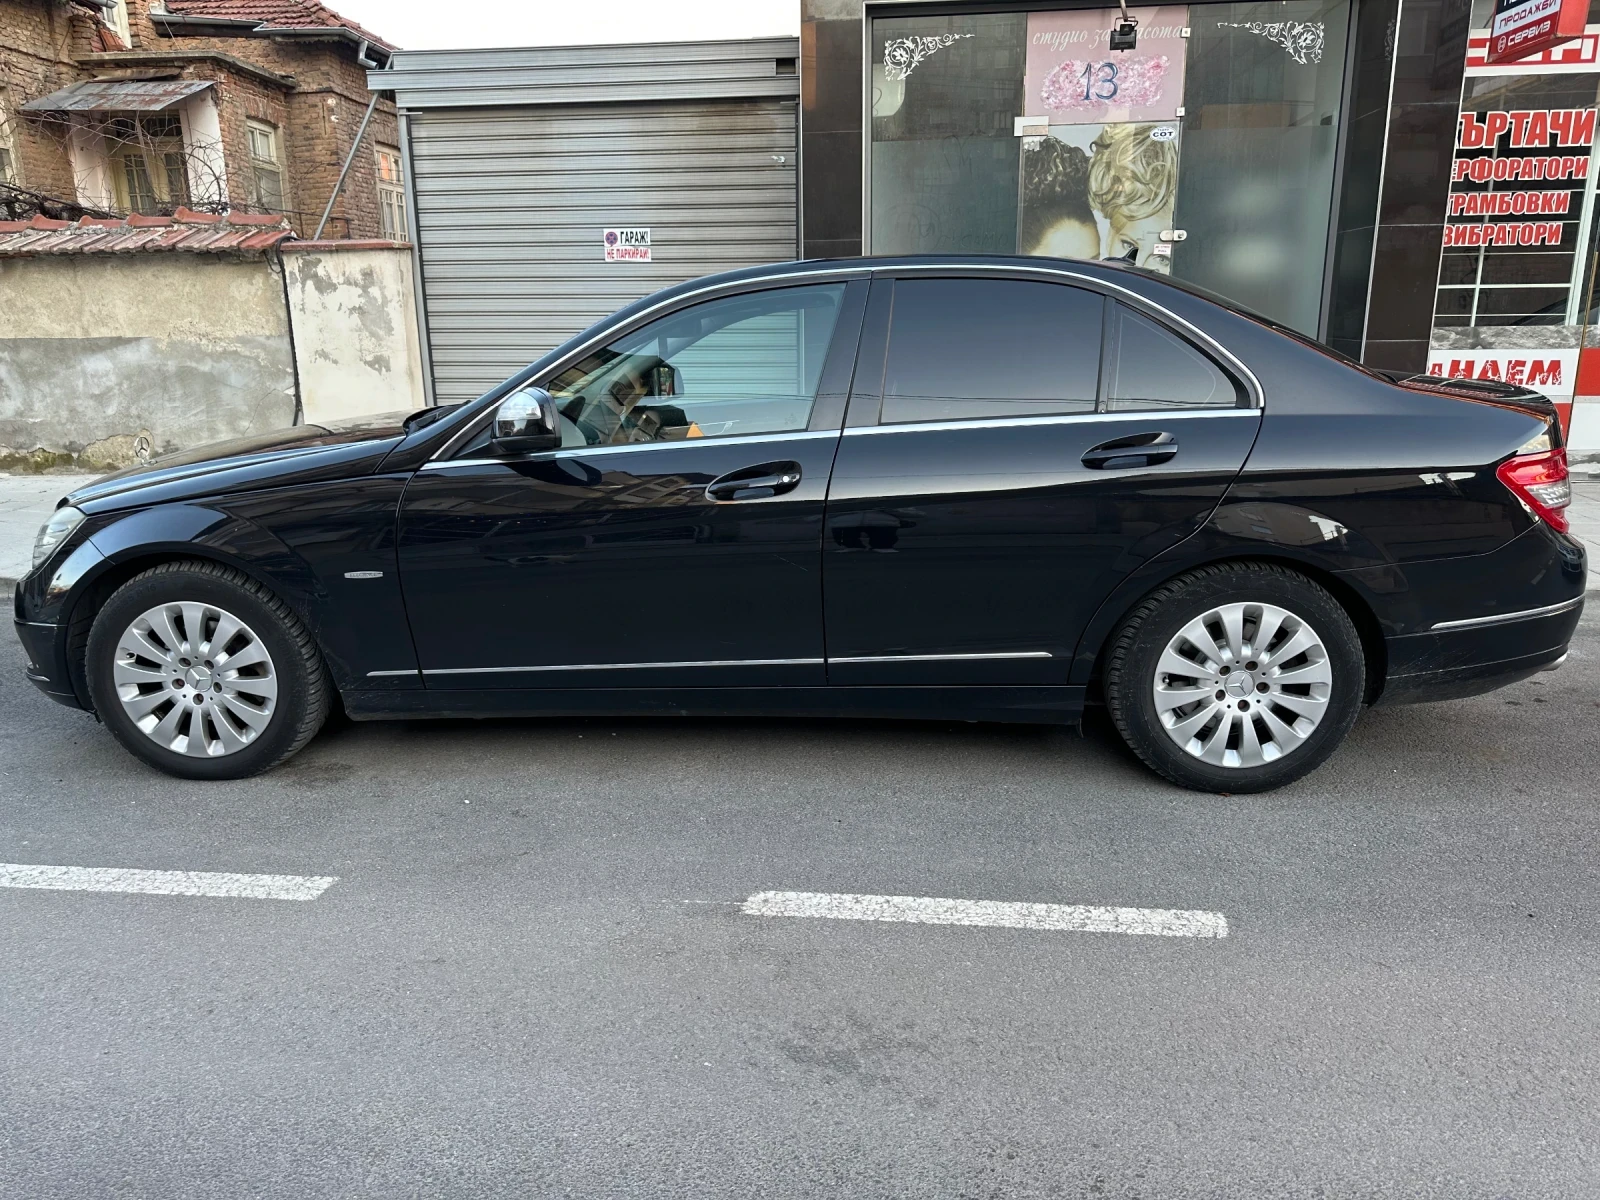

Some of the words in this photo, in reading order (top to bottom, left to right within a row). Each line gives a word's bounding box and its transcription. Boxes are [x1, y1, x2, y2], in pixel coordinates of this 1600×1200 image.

[1498, 0, 1557, 29] ПРОДАЖБИ
[1507, 20, 1551, 46] СЕРВИЗ
[1080, 62, 1119, 101] 13
[1456, 109, 1598, 149] ЪРТАЧИ
[1452, 156, 1590, 183] РФОРАТОРИ
[606, 248, 615, 260] НЕ
[1447, 359, 1562, 386] НАЕМ
